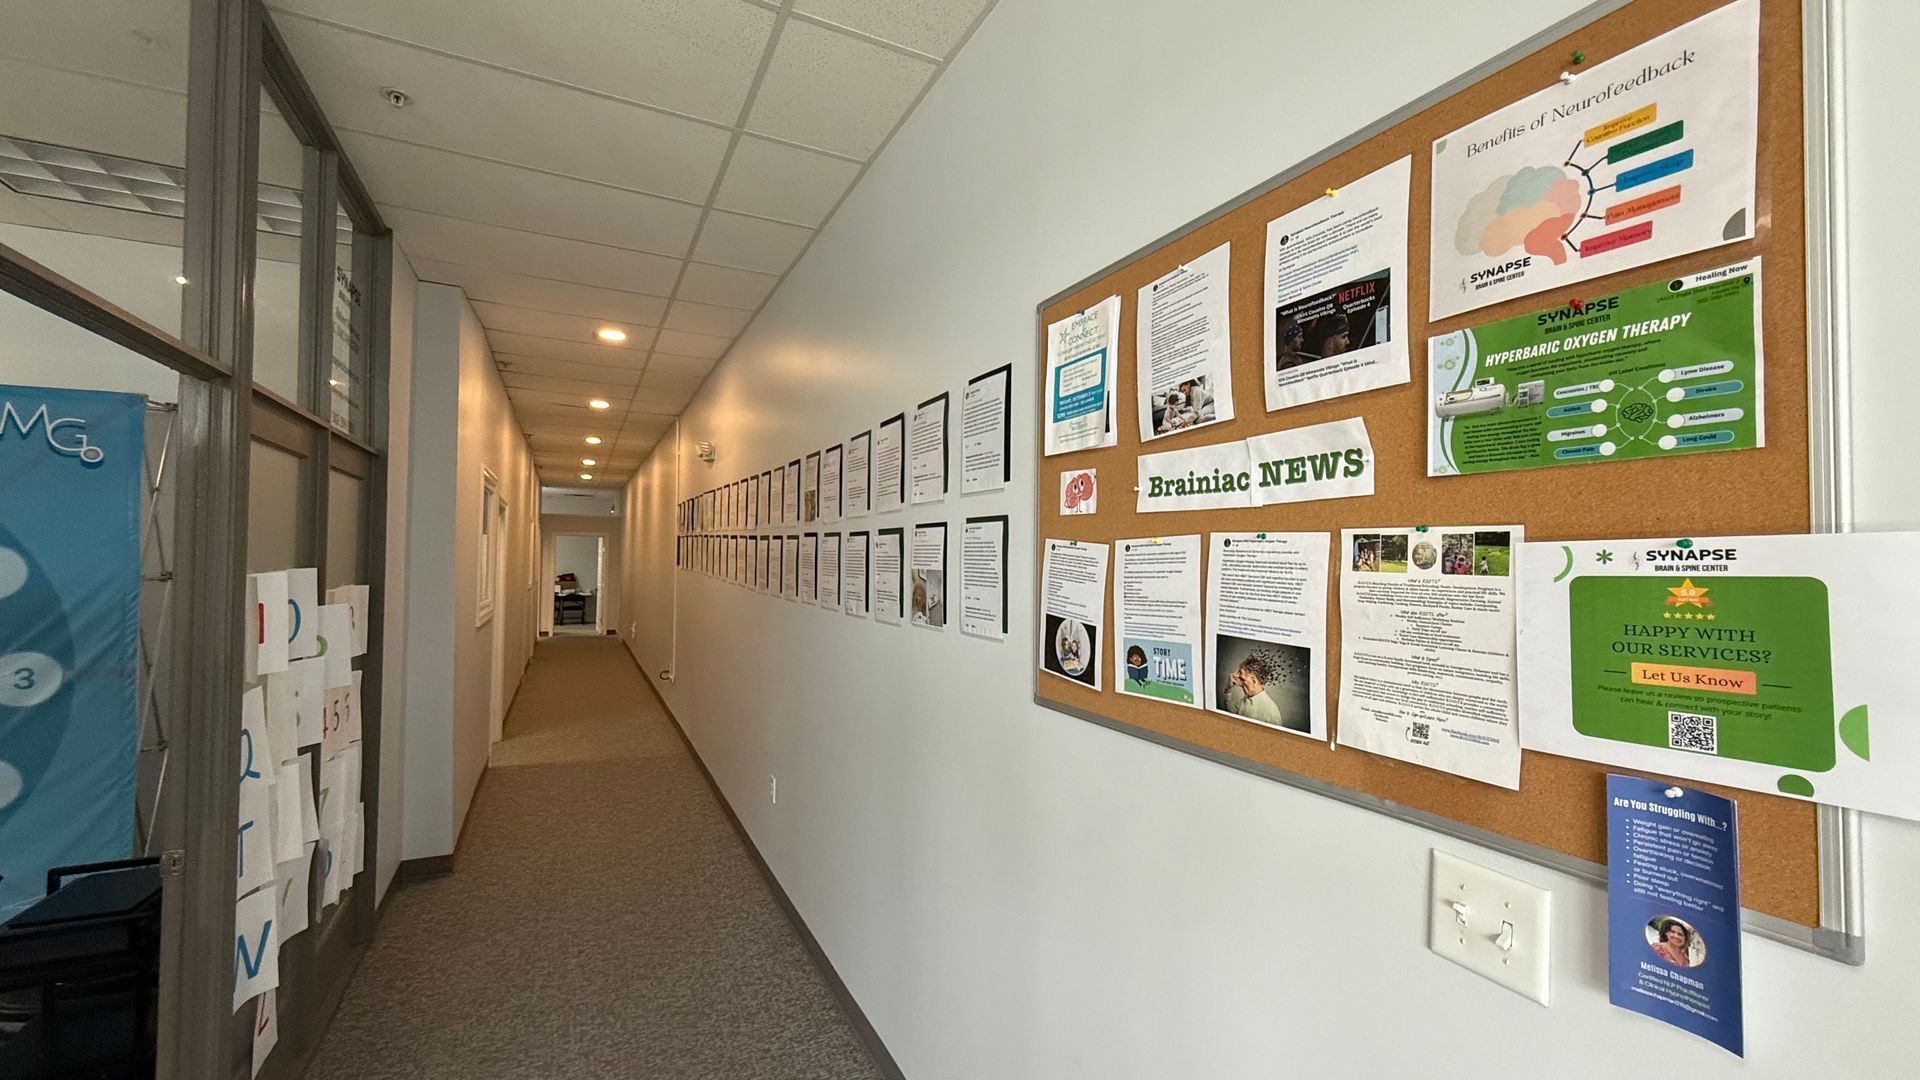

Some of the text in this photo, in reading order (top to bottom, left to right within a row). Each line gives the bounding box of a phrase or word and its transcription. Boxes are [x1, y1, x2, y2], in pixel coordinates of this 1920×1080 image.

[1467, 49, 1696, 158] Benefits of Neurofeedback
[1606, 209, 1625, 220] Pain
[1470, 256, 1531, 284] SYNAPSE
[1696, 264, 1748, 283] Healing Now
[1475, 282, 1488, 290] BRAIN
[1492, 276, 1506, 285] SPINE
[1506, 271, 1525, 281] CENTER
[1338, 281, 1376, 305] NETFLIX
[1342, 295, 1376, 310] Quarterbacks
[1347, 304, 1366, 315] Episode
[1296, 308, 1336, 324] Minnesota Vikings
[1308, 306, 1326, 316] Cousins
[1537, 297, 1619, 326] SYNAPSE
[1072, 311, 1099, 330] EMBRACE
[1545, 322, 1562, 334] BRAIN
[1568, 319, 1586, 330] SPINE
[1586, 314, 1611, 327] CENTER
[1068, 326, 1099, 346] CONNECT
[1485, 340, 1560, 368] HYPERBARIC
[1563, 328, 1618, 351] OXYGEN
[1622, 312, 1692, 340] THERAPY
[1319, 369, 1344, 377] Quarterback
[1343, 364, 1360, 372] Episode
[1681, 364, 1725, 377] Lyme Disease
[1556, 385, 1585, 396] Concussion
[1696, 386, 1717, 394] Stroke
[1688, 412, 1725, 421] Alzheimers
[1561, 429, 1586, 437] Migraines
[1682, 436, 1699, 444] Long
[1148, 448, 1365, 499] Brainiac NEWS
[1646, 549, 1737, 561] SYNAPSE
[1702, 564, 1728, 572] CENTER
[1623, 624, 1756, 643] HAPPY WITH
[1153, 647, 1171, 656] STORY
[1612, 641, 1772, 664] OUR SERVICES?
[1153, 656, 1187, 681] TIME
[13, 668, 35, 690] 3
[1642, 670, 1744, 689] Let Us Know
[1598, 684, 1622, 693] Please
[1623, 687, 1644, 695] leave
[1664, 693, 1692, 701] review
[1706, 696, 1760, 709] prospective
[1762, 702, 1802, 712] patients
[1636, 697, 1654, 706] hear
[1664, 701, 1698, 712] connect
[1700, 705, 1719, 714] with
[1722, 708, 1742, 718] your
[1614, 797, 1629, 808] Are
[1630, 799, 1647, 811] You
[1648, 802, 1696, 823] Struggling
[1632, 819, 1656, 828] Weight
[1633, 825, 1657, 836] Fatigue
[1658, 830, 1672, 838] that
[1633, 832, 1658, 842] Chronic
[1660, 838, 1680, 848] stress
[1633, 839, 1666, 851] Persistent
[1667, 848, 1682, 856] pain
[1691, 853, 1714, 865] tension
[1633, 852, 1657, 864] fatigue
[1633, 846, 1675, 861] Overthinking
[1684, 858, 1711, 872] decision
[1633, 860, 1658, 871] Feeling
[1642, 868, 1666, 879] burned
[1633, 880, 1654, 891] Doing
[1634, 873, 1670, 887] Poor sleep
[1659, 893, 1683, 906] feeling
[1683, 901, 1704, 911] better
[1638, 972, 1663, 984] Certified
[1640, 961, 1704, 991] Melissa Chapman
[1644, 981, 1665, 992] Clinical
